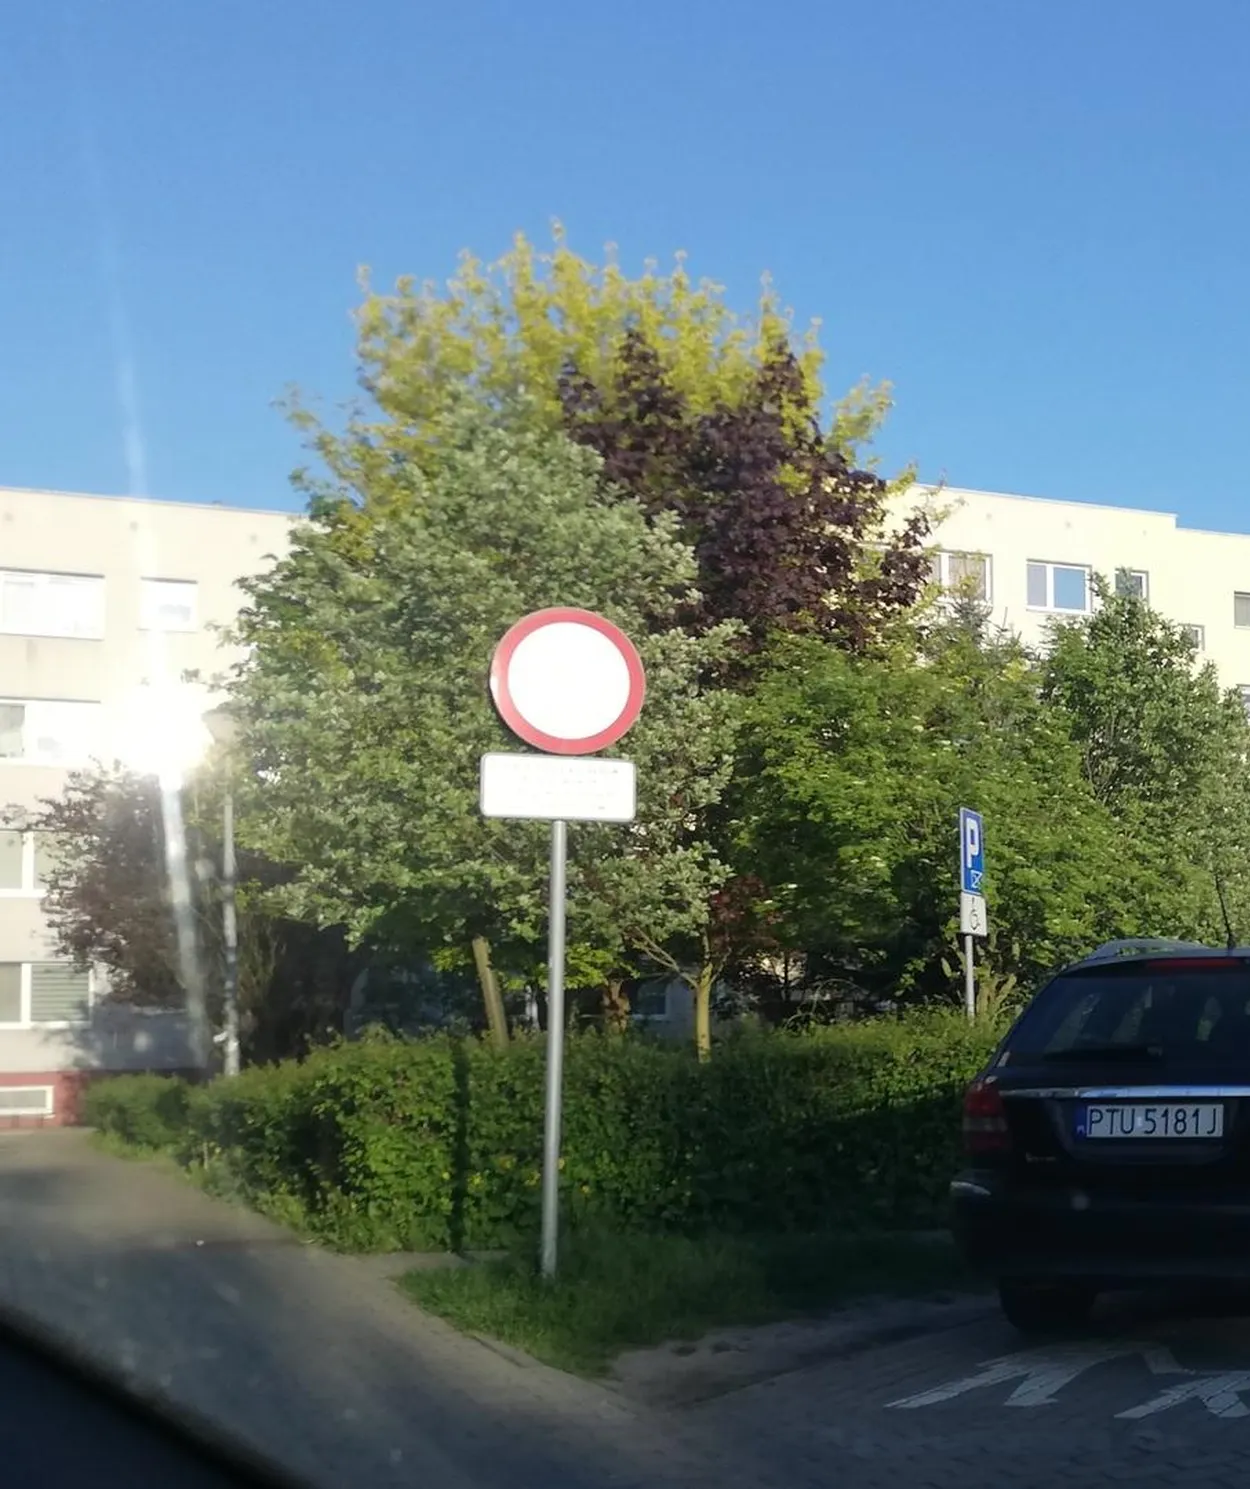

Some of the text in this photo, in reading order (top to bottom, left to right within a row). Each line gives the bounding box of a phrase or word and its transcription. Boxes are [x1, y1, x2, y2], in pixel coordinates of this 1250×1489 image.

[966, 817, 980, 869] P
[1088, 1107, 1217, 1135] PTU 5181J
